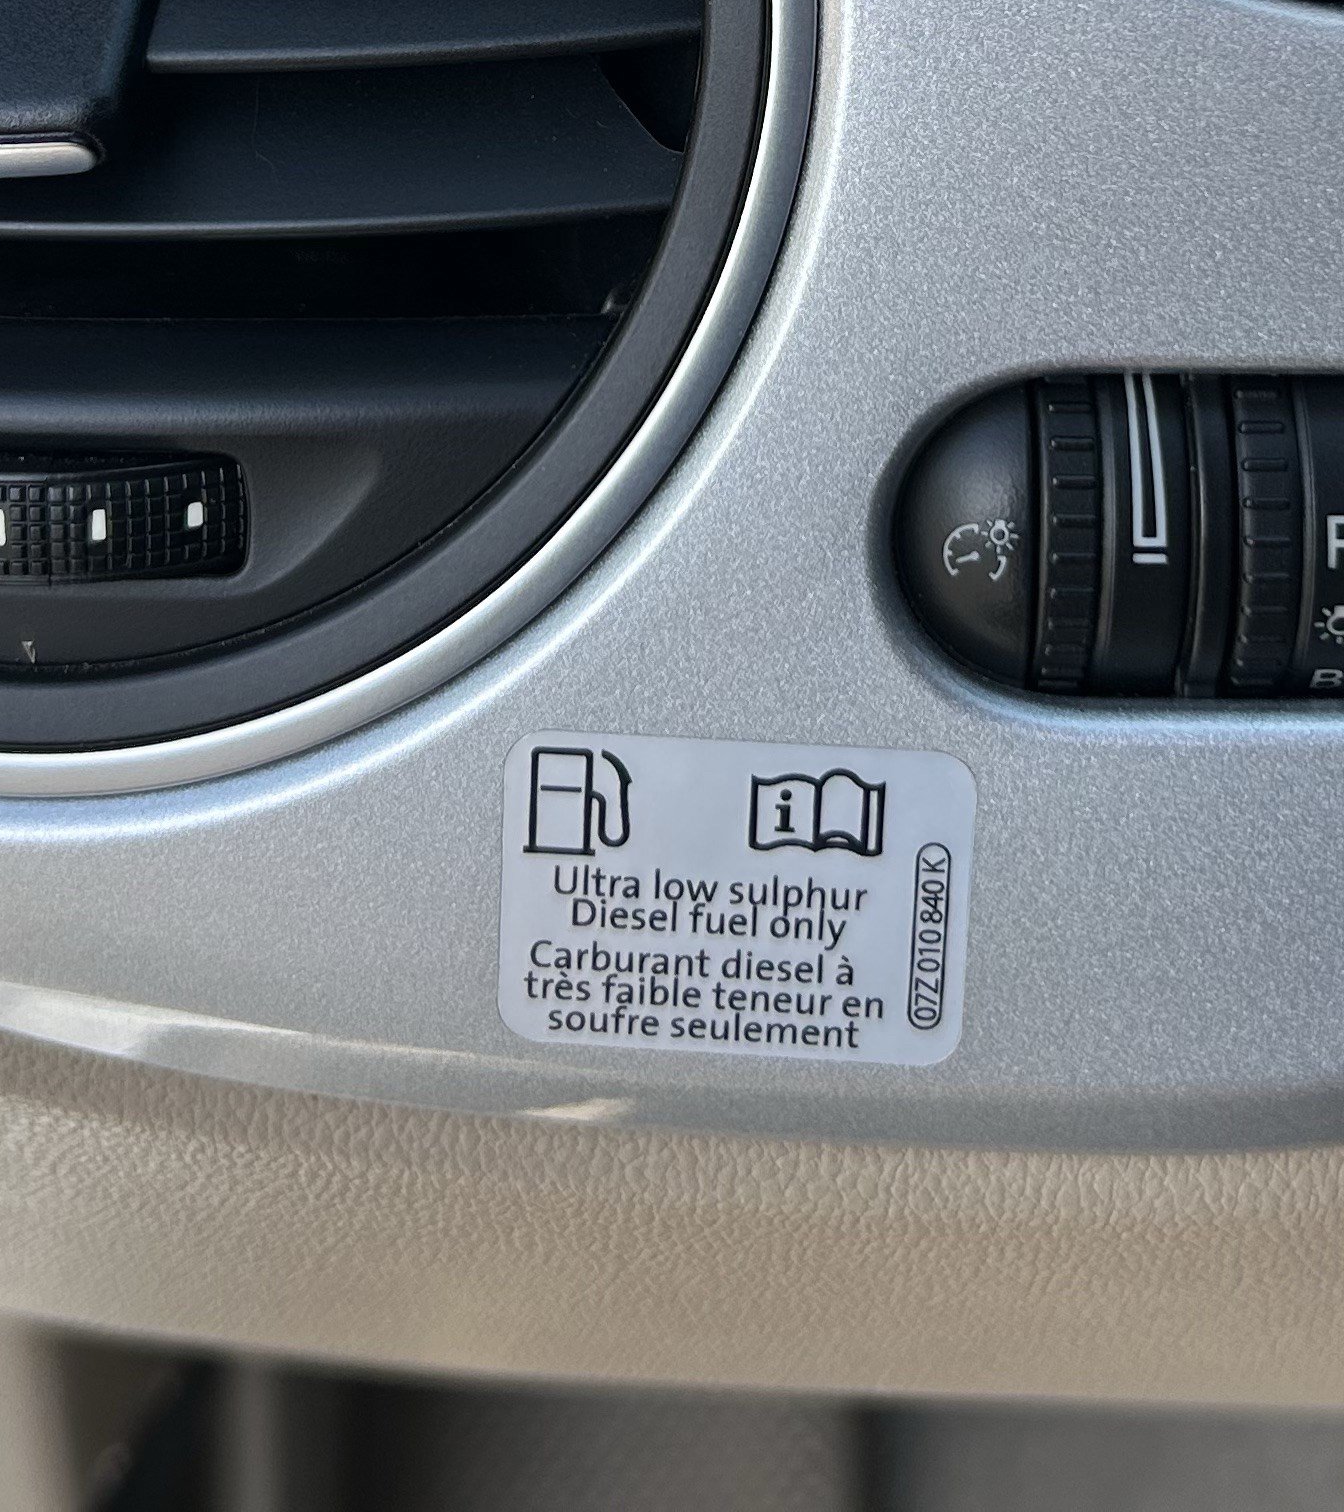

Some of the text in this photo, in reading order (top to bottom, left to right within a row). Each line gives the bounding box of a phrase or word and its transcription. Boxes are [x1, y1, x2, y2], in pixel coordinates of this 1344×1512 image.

[554, 864, 868, 917] Ultra low sulphur
[571, 897, 847, 951] Diesel fuel only
[529, 939, 854, 986] Carburant diesel à
[524, 970, 884, 1019] très faible teneur en
[548, 1005, 860, 1048] soufre seulement
